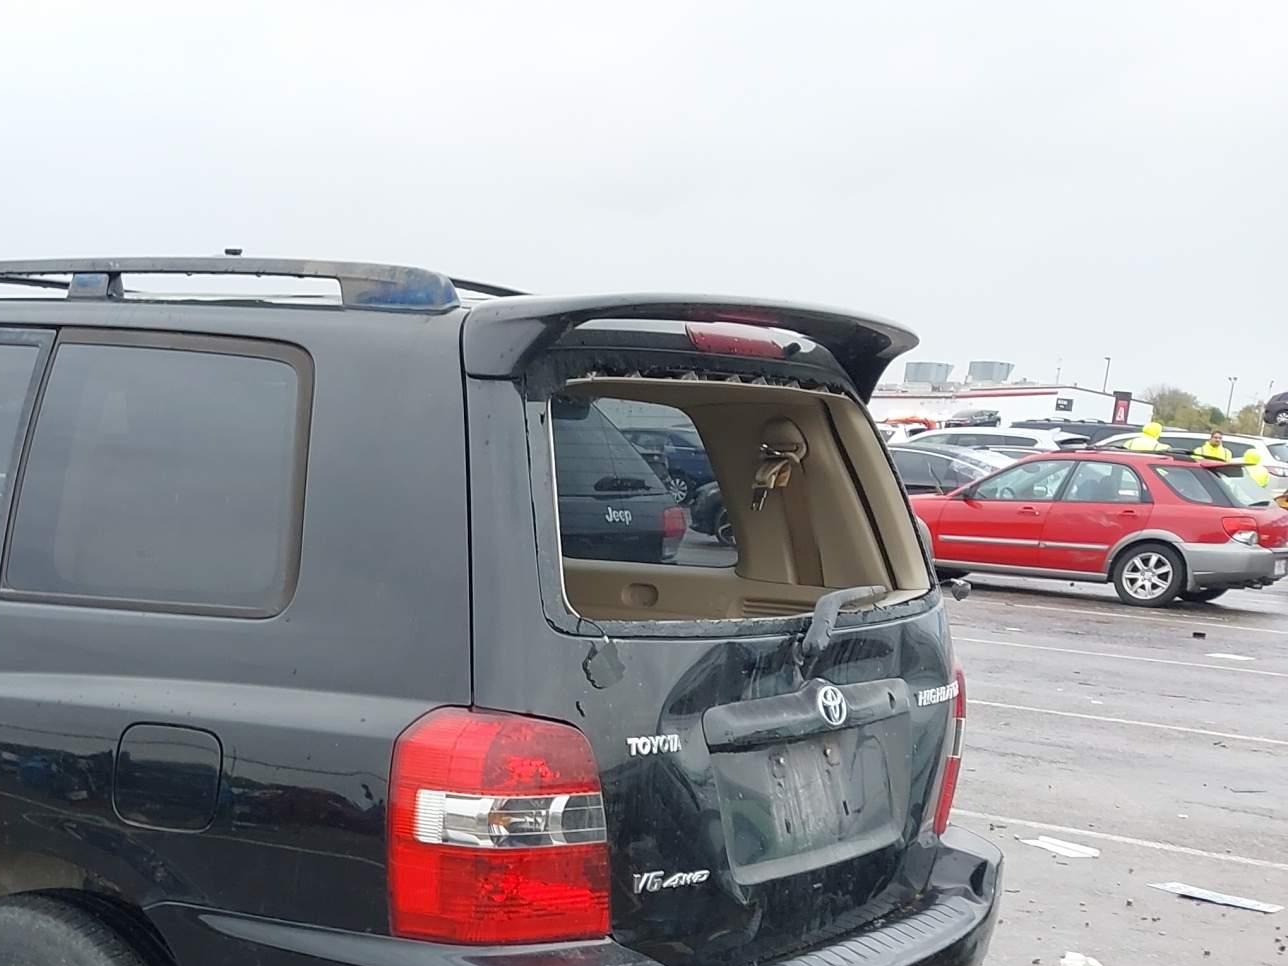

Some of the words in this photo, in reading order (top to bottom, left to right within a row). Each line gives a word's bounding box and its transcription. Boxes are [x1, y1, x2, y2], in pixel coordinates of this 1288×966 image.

[605, 506, 632, 526] Jeep
[626, 733, 683, 757] TOYOTA
[632, 869, 665, 894] V6
